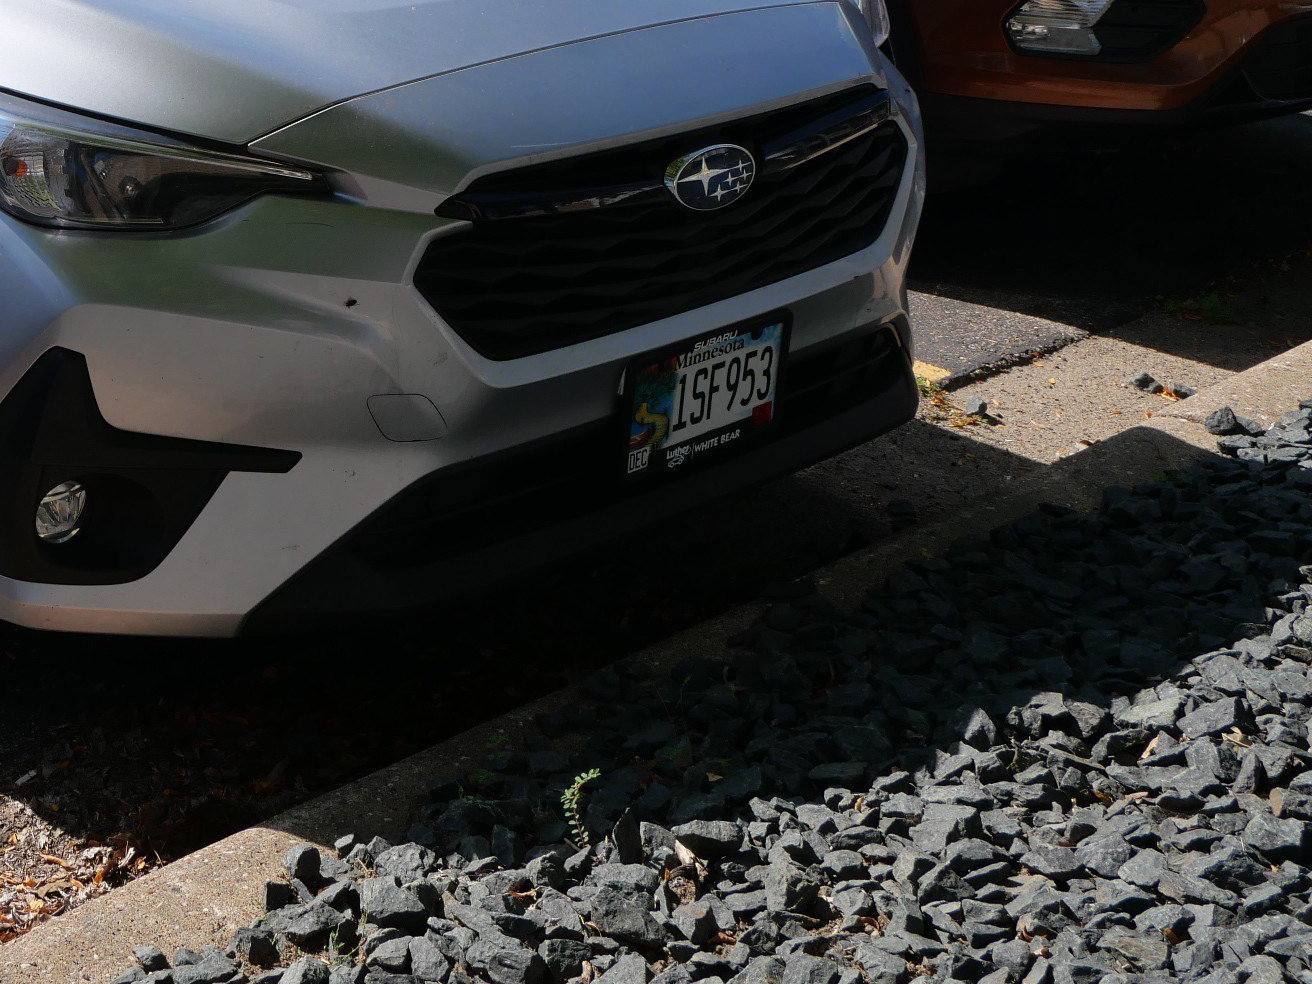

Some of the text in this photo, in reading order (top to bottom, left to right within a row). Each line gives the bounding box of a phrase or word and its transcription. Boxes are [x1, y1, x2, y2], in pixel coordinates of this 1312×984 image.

[693, 329, 738, 351] SUBARU
[673, 338, 745, 371] Minnesota
[672, 345, 774, 432] 1SF953
[694, 437, 719, 453] WHITE
[720, 429, 741, 445] BEAR
[628, 448, 649, 472] DEC
